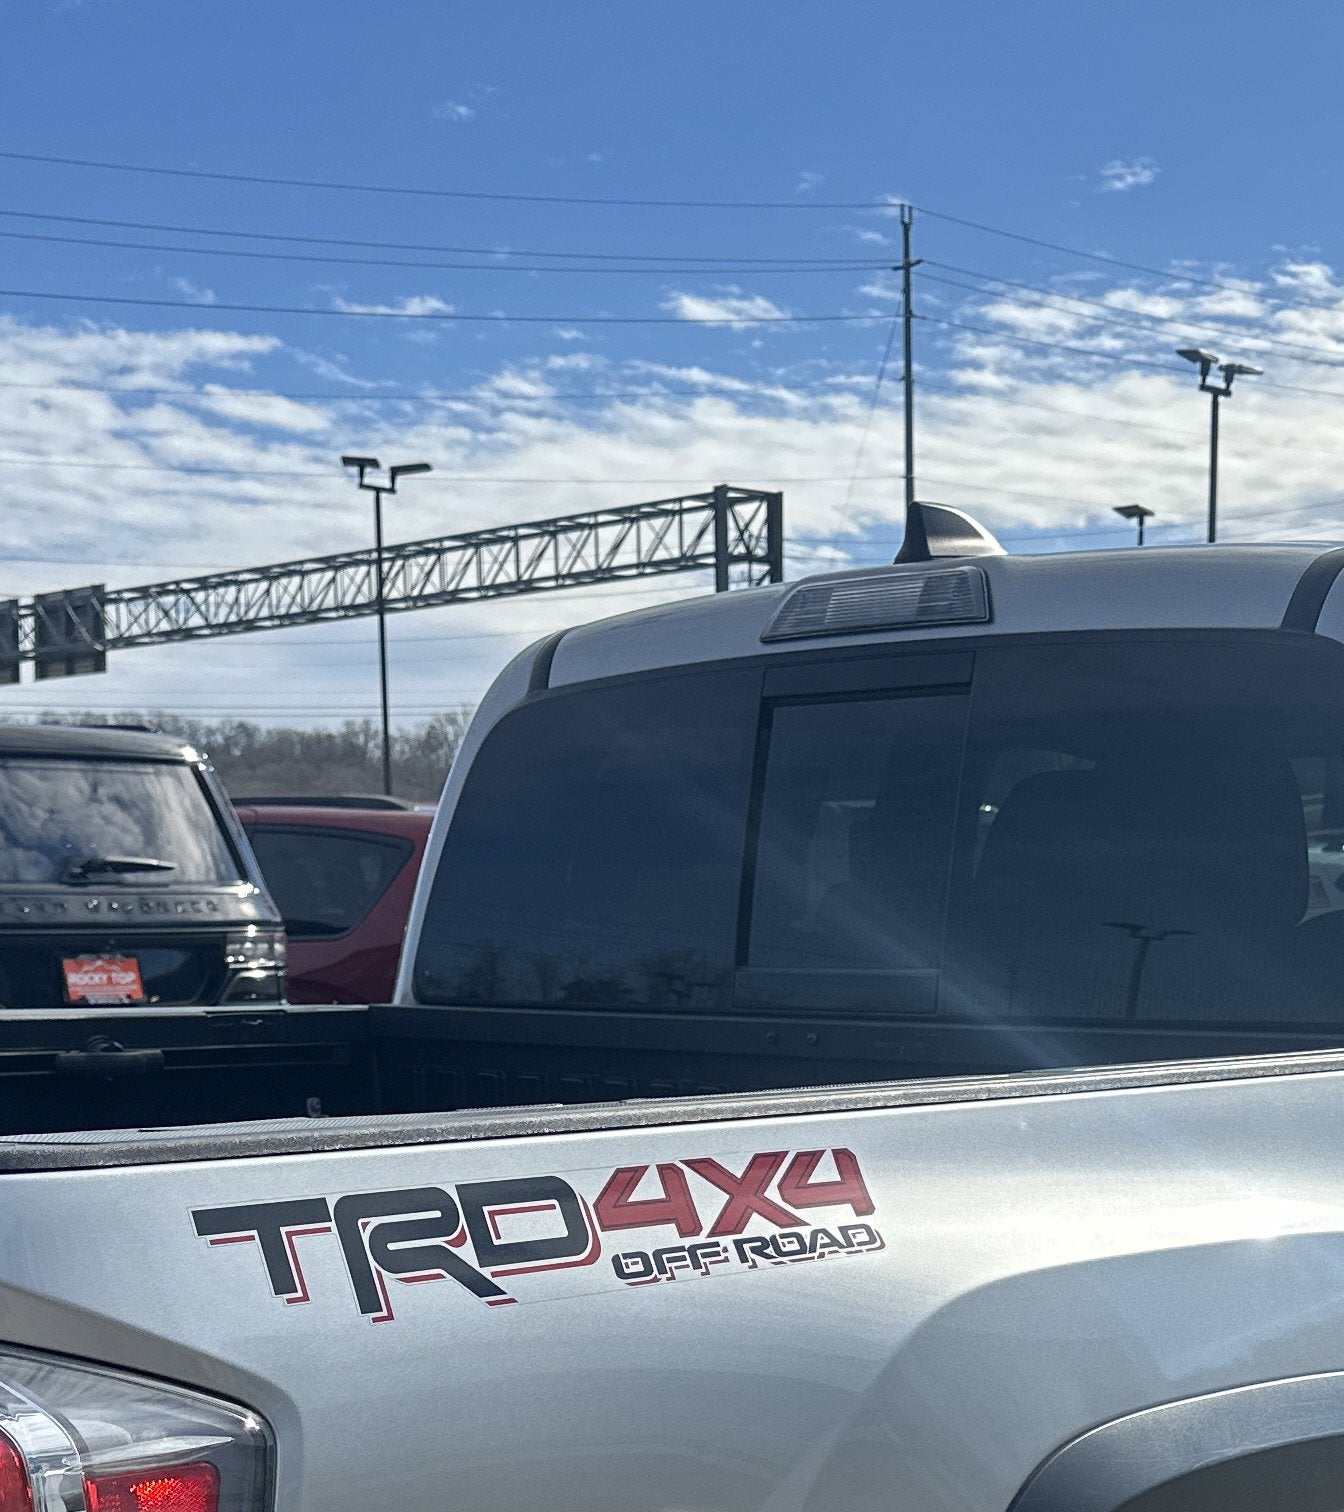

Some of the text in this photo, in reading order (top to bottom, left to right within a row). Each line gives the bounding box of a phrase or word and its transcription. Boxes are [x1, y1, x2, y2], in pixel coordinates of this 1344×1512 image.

[190, 1175, 601, 1325] TRD
[612, 1222, 886, 1286] OFF ROAD
